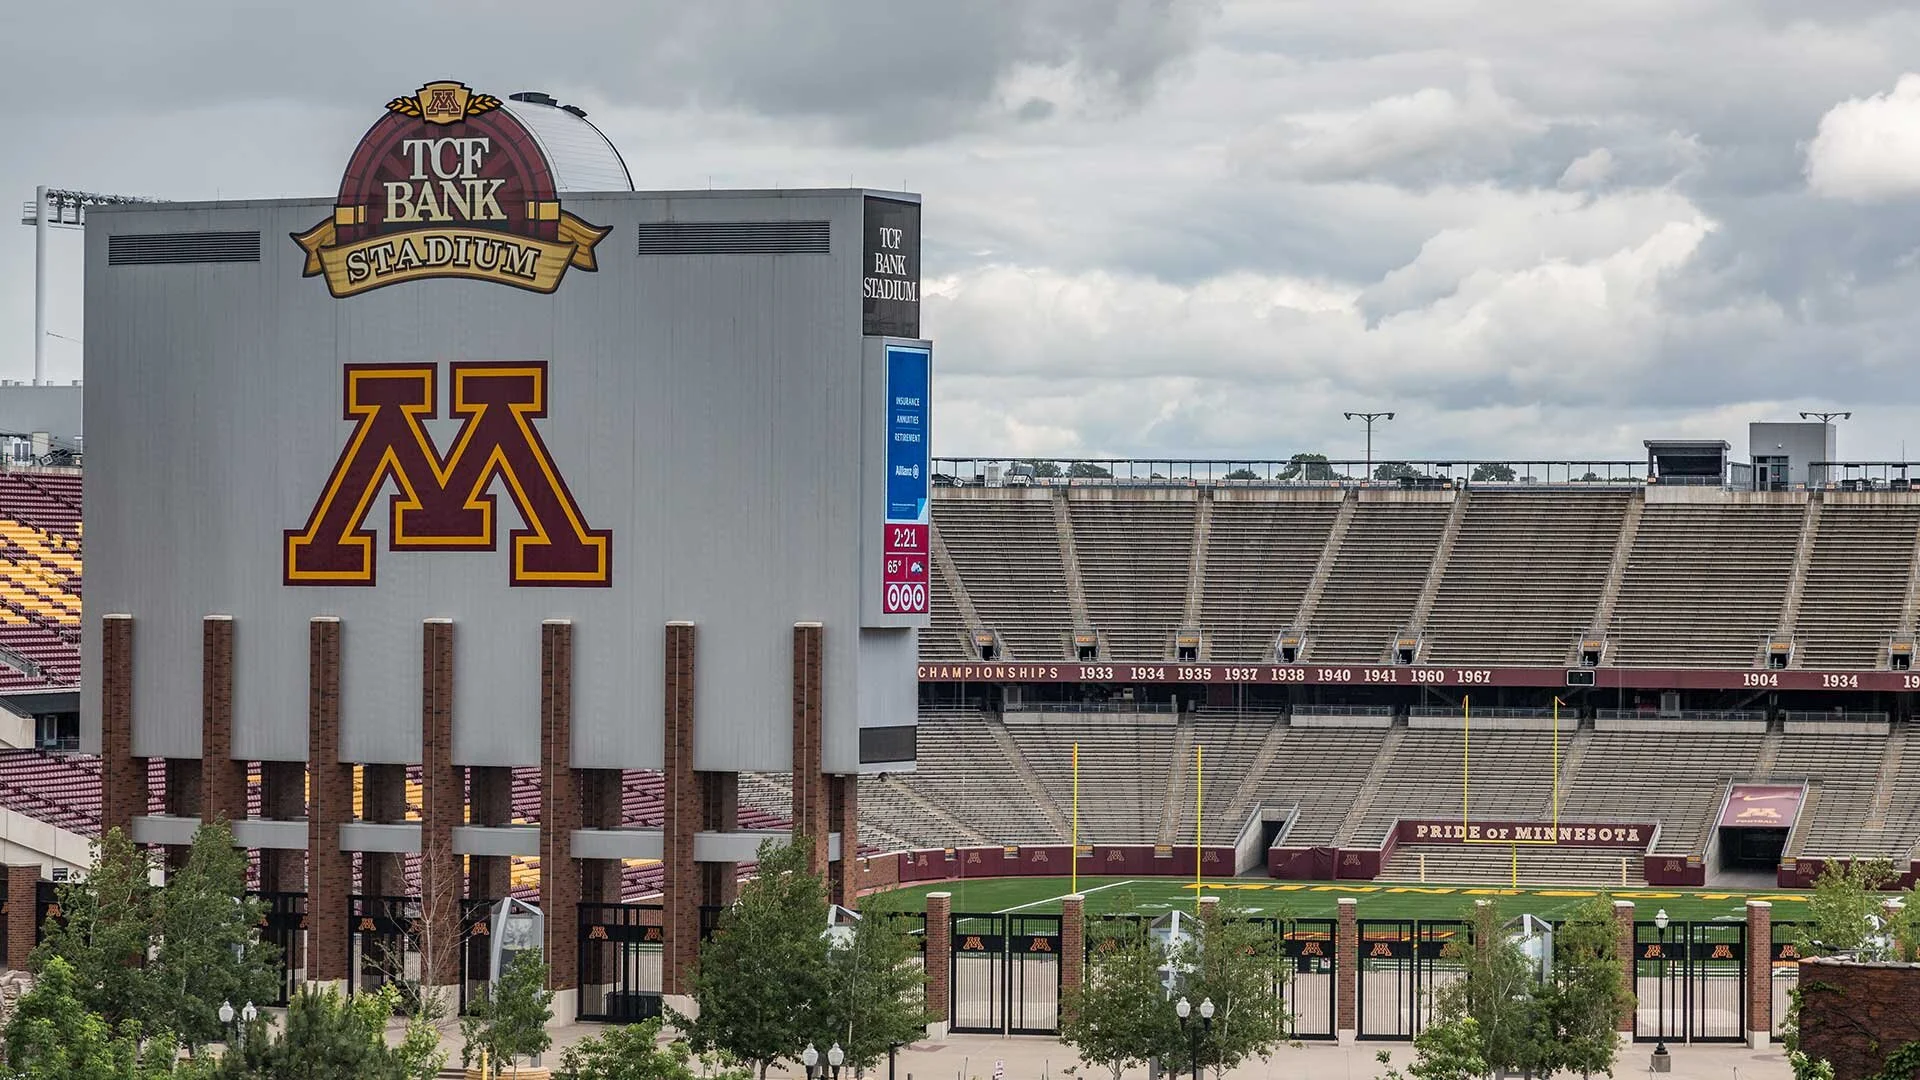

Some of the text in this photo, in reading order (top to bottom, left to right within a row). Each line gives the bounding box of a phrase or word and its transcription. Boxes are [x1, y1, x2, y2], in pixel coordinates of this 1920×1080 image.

[403, 137, 489, 180] TCF
[382, 178, 507, 223] BANK
[880, 227, 902, 249] TCF
[346, 236, 542, 284] STADIUM
[875, 252, 907, 276] BANK
[895, 397, 920, 406] INSURANCE
[896, 415, 919, 425] ANNUITIES
[895, 433, 920, 442] RETIREMENT
[283, 360, 612, 588] M
[895, 465, 912, 476] Allianz
[894, 528, 917, 548] 2:21
[918, 666, 1491, 683] CHAMPIONSHIPS 1933 1934 1935 1937 1938 1940 1941 1960 1967
[1743, 673, 1778, 687] 1904
[1822, 674, 1858, 688] 1934
[1417, 825, 1480, 839] PRIDE
[1515, 827, 1640, 842] MINNESOTA
[1181, 883, 1810, 902] MINNESOTA
